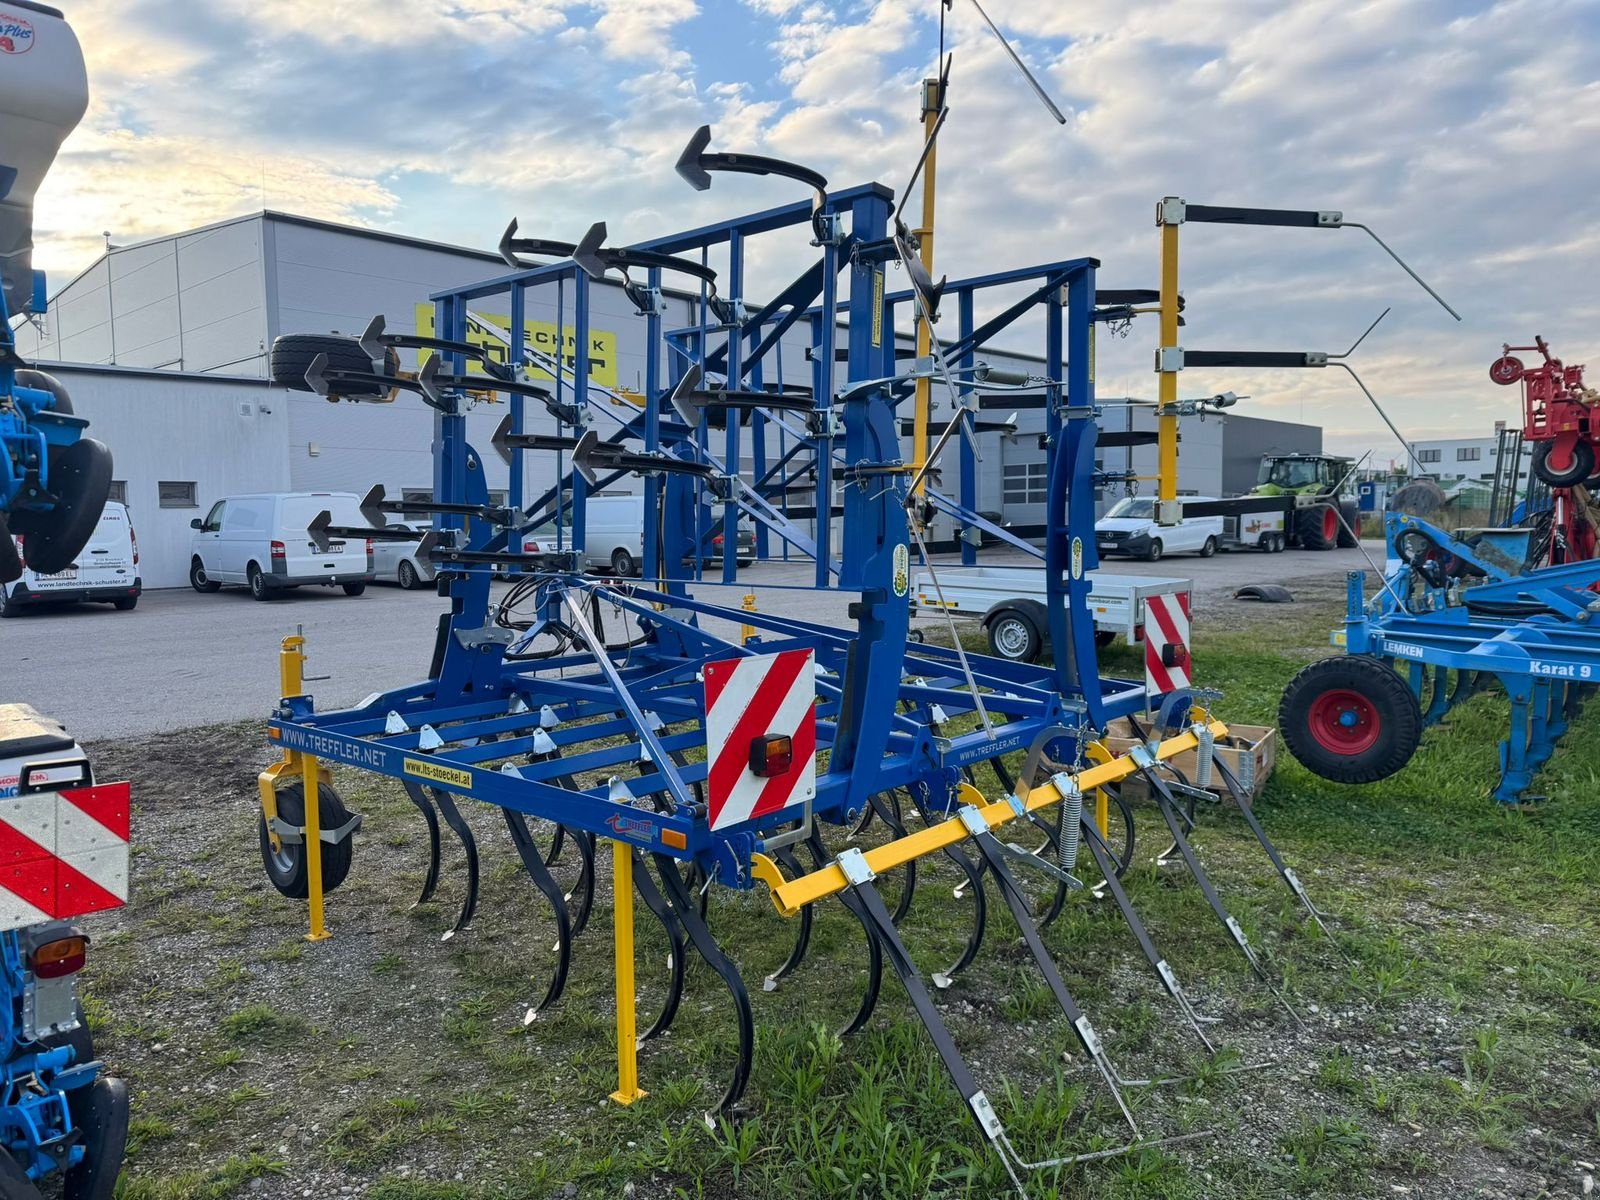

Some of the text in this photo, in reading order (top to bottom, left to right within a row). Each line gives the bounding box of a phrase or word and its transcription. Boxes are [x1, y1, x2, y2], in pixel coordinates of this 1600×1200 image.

[37, 579, 128, 588] www.landtechnik-schuster.at
[1383, 641, 1424, 658] LEMKEN
[1529, 661, 1591, 678] Karat 9
[281, 727, 387, 768] WWW.TREFFLER.NET
[959, 736, 1020, 760] WWW.TREFFLER.NET
[405, 761, 471, 786] www.lts-stoeckel.at
